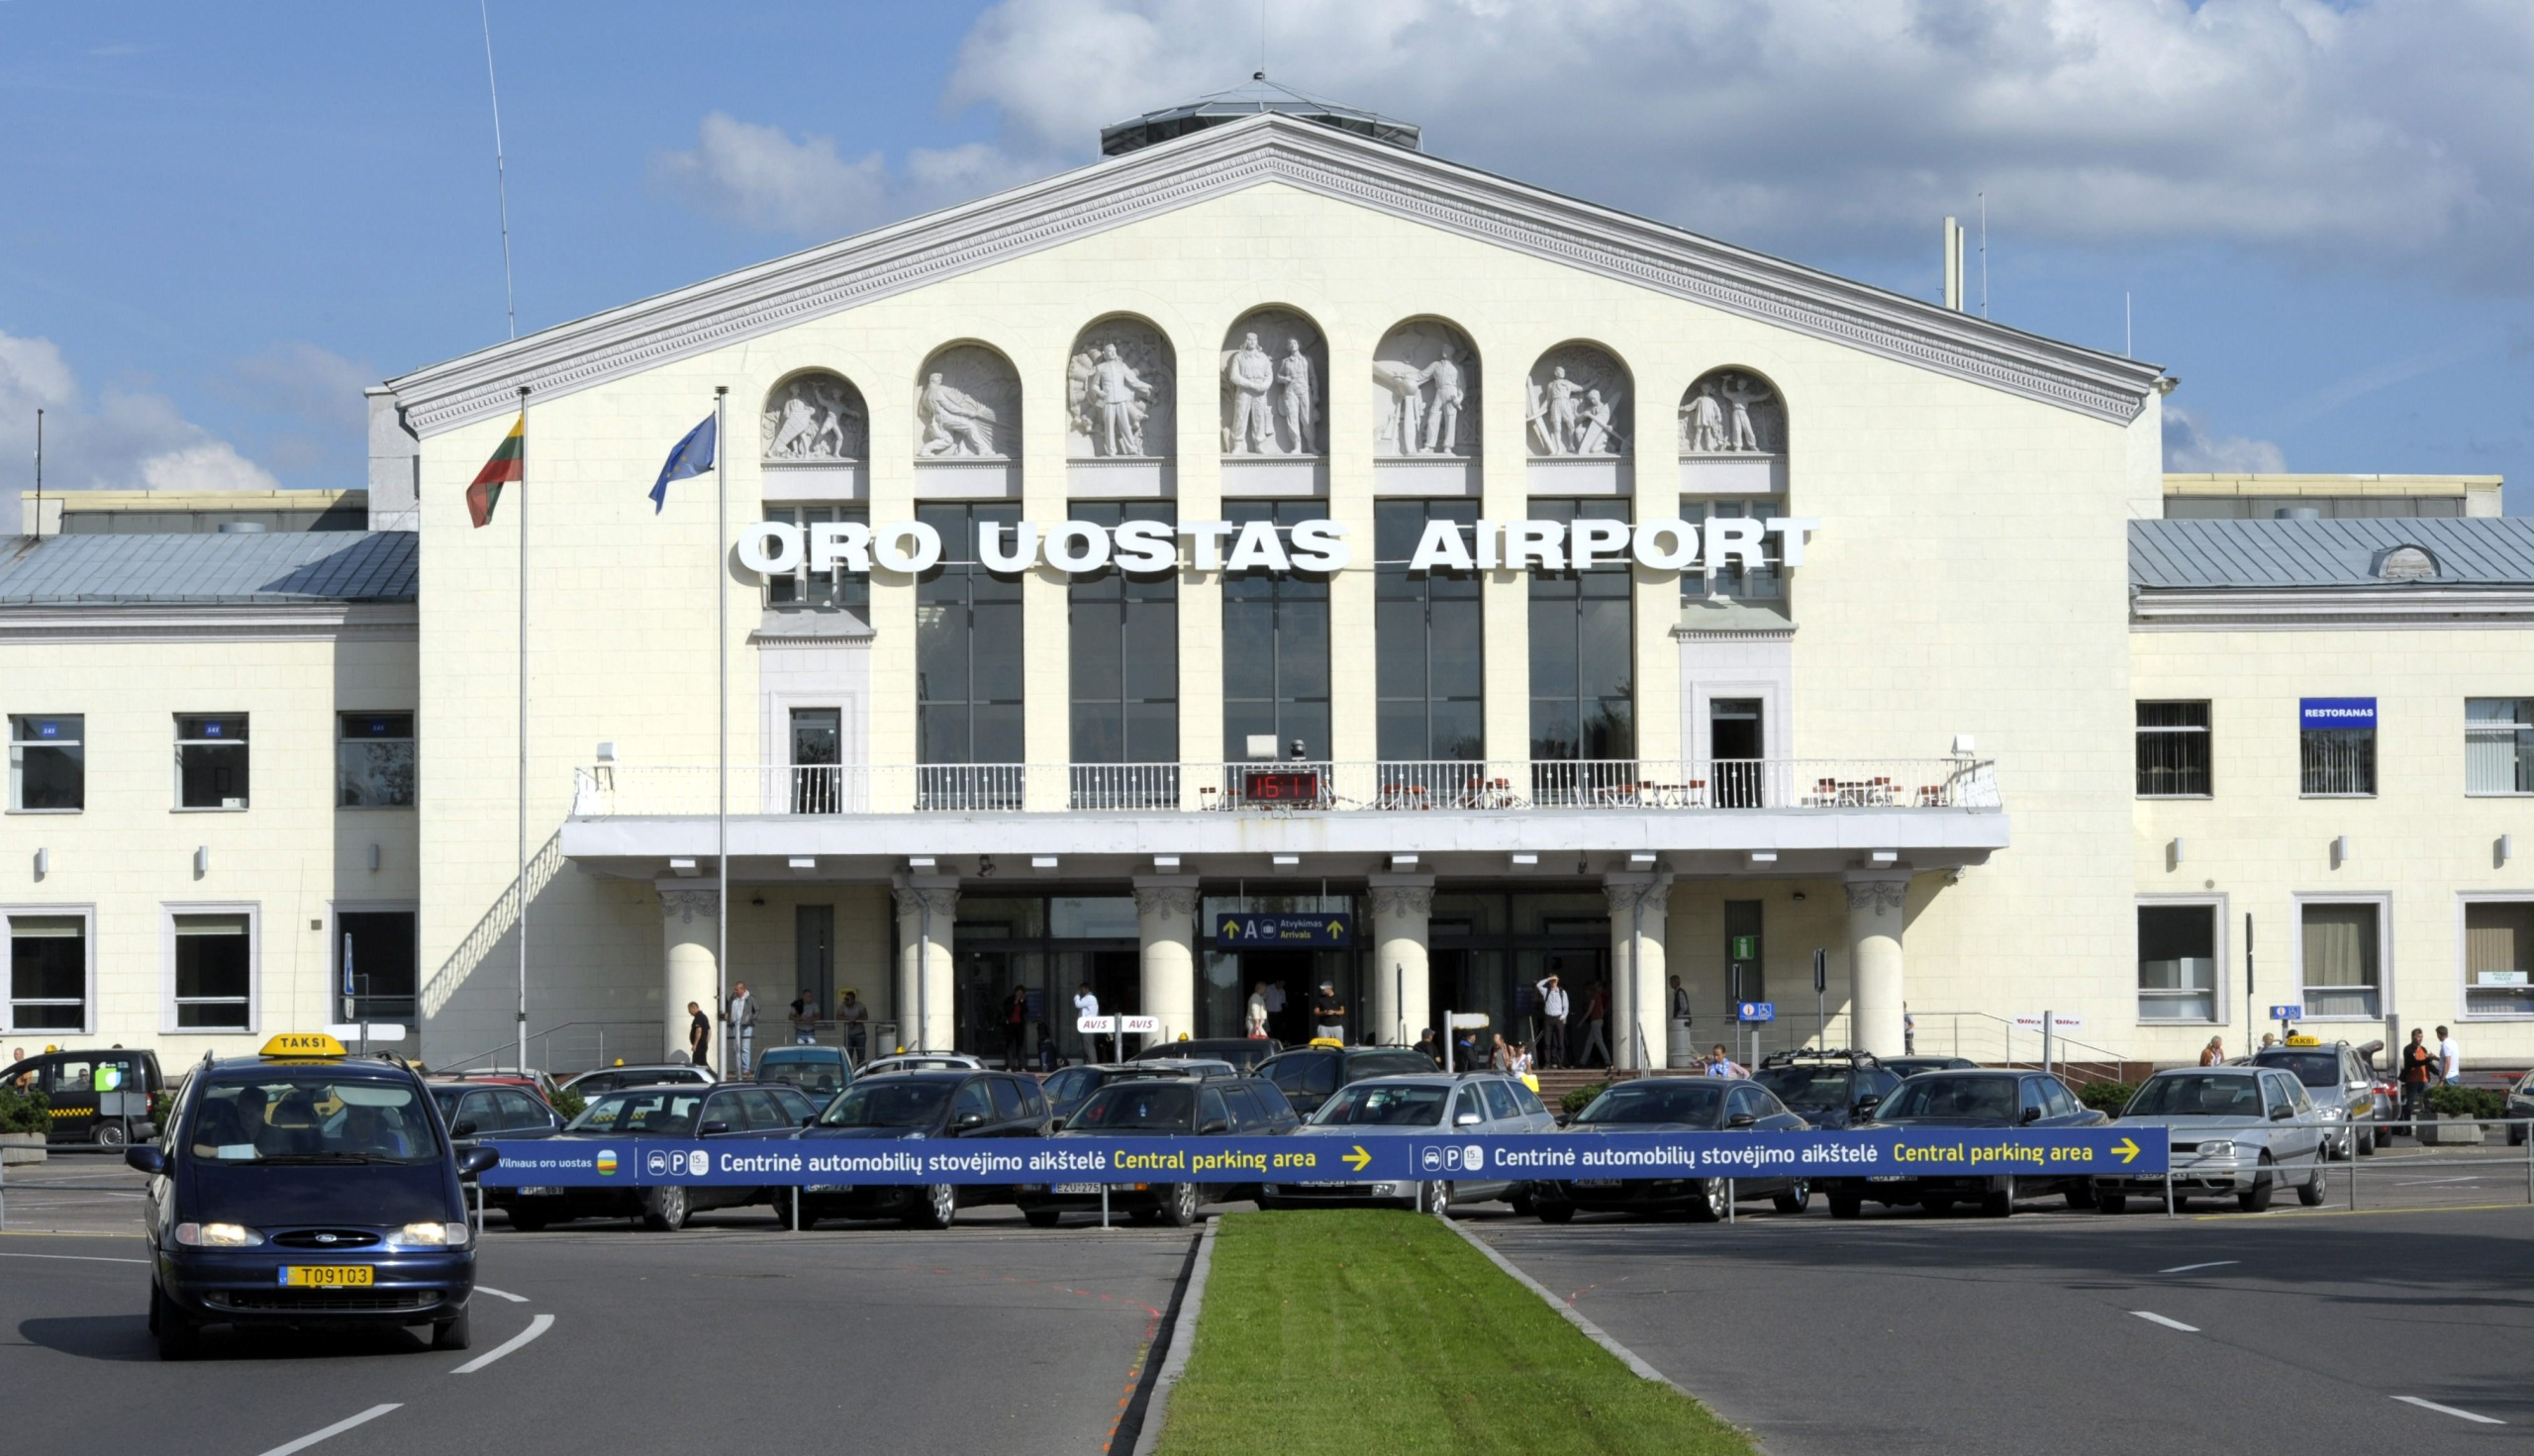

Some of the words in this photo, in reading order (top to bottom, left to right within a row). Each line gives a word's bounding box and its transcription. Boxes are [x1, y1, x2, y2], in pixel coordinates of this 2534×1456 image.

[737, 520, 942, 573] ORO
[978, 519, 1353, 573] UOSTAS
[1408, 517, 1821, 571] AIRPORT
[2304, 709, 2374, 718] RESTORANAS
[1256, 775, 1316, 798] 16:11
[1244, 920, 1258, 939] A
[1280, 920, 1322, 929] Atvykimas
[1280, 930, 1312, 939] Arrivals
[1083, 1020, 1108, 1029] AVIS
[1128, 1019, 1153, 1028] AVIS
[280, 1037, 326, 1048] TAKSI
[692, 1154, 701, 1164] 15
[1466, 1149, 1475, 1159] 15
[1495, 1147, 1577, 1167] Centrinė
[1582, 1145, 1696, 1170] automobilių
[1702, 1145, 1796, 1169] stovėjimo
[1802, 1142, 1879, 1163] aikštelė
[1894, 1142, 1965, 1163] Central
[1970, 1142, 2045, 1166] parking
[2050, 1145, 2094, 1161] area
[498, 1157, 537, 1169] Vilniaus
[558, 1159, 593, 1168] uostas
[721, 1153, 802, 1172] Centrinė
[809, 1151, 923, 1176] automobilių
[928, 1151, 1023, 1176] stovėjimo
[1028, 1150, 1107, 1171] aikštelė
[1115, 1149, 1185, 1170] Central
[1192, 1149, 1268, 1174] parking
[1273, 1152, 1316, 1168] area
[1057, 1183, 1077, 1193] EZU
[1082, 1183, 1100, 1193] 275
[301, 1268, 367, 1284] T09103
